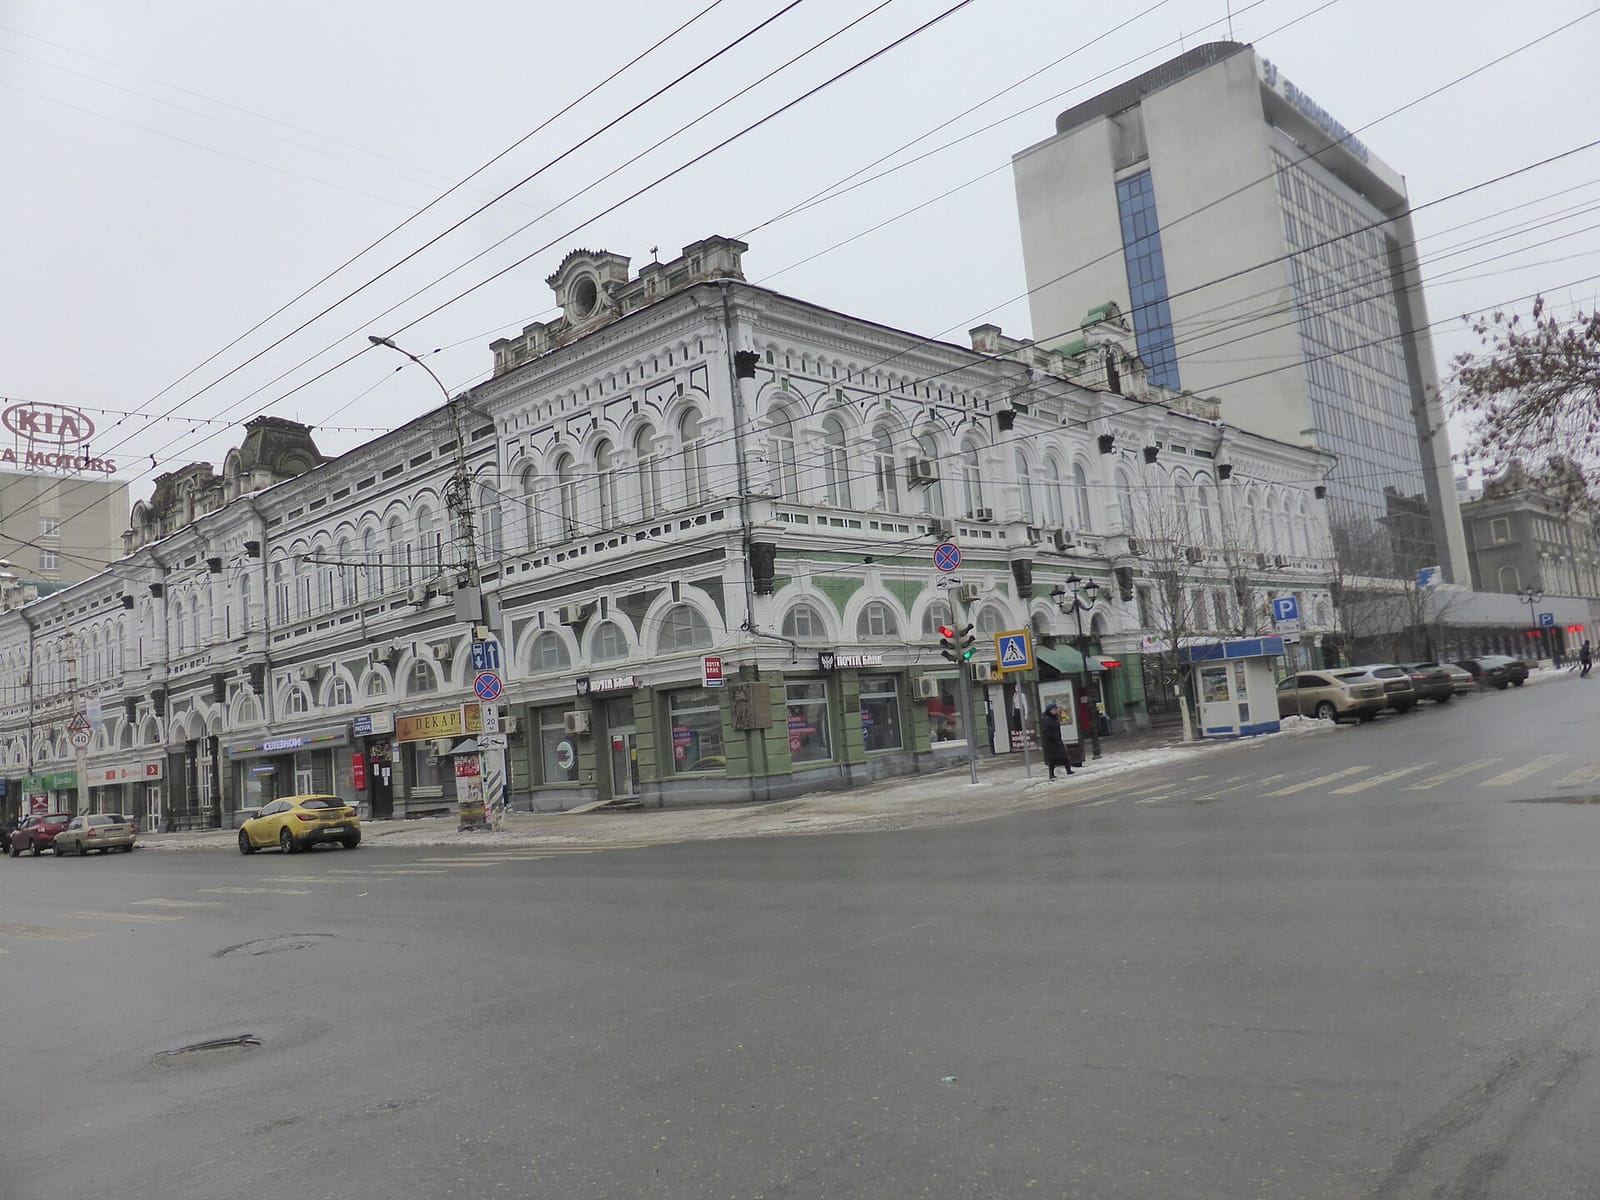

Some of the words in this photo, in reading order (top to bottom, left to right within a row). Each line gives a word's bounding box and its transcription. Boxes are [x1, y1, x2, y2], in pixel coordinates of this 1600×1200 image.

[18, 409, 80, 438] KIA
[26, 450, 118, 474] MOTORS
[1280, 601, 1293, 619] P
[1542, 615, 1551, 625] P
[837, 655, 862, 667] ПОЧТА
[863, 654, 882, 665] БАНК
[486, 718, 496, 726] 20
[355, 724, 372, 733] NOVA
[75, 735, 87, 744] 40
